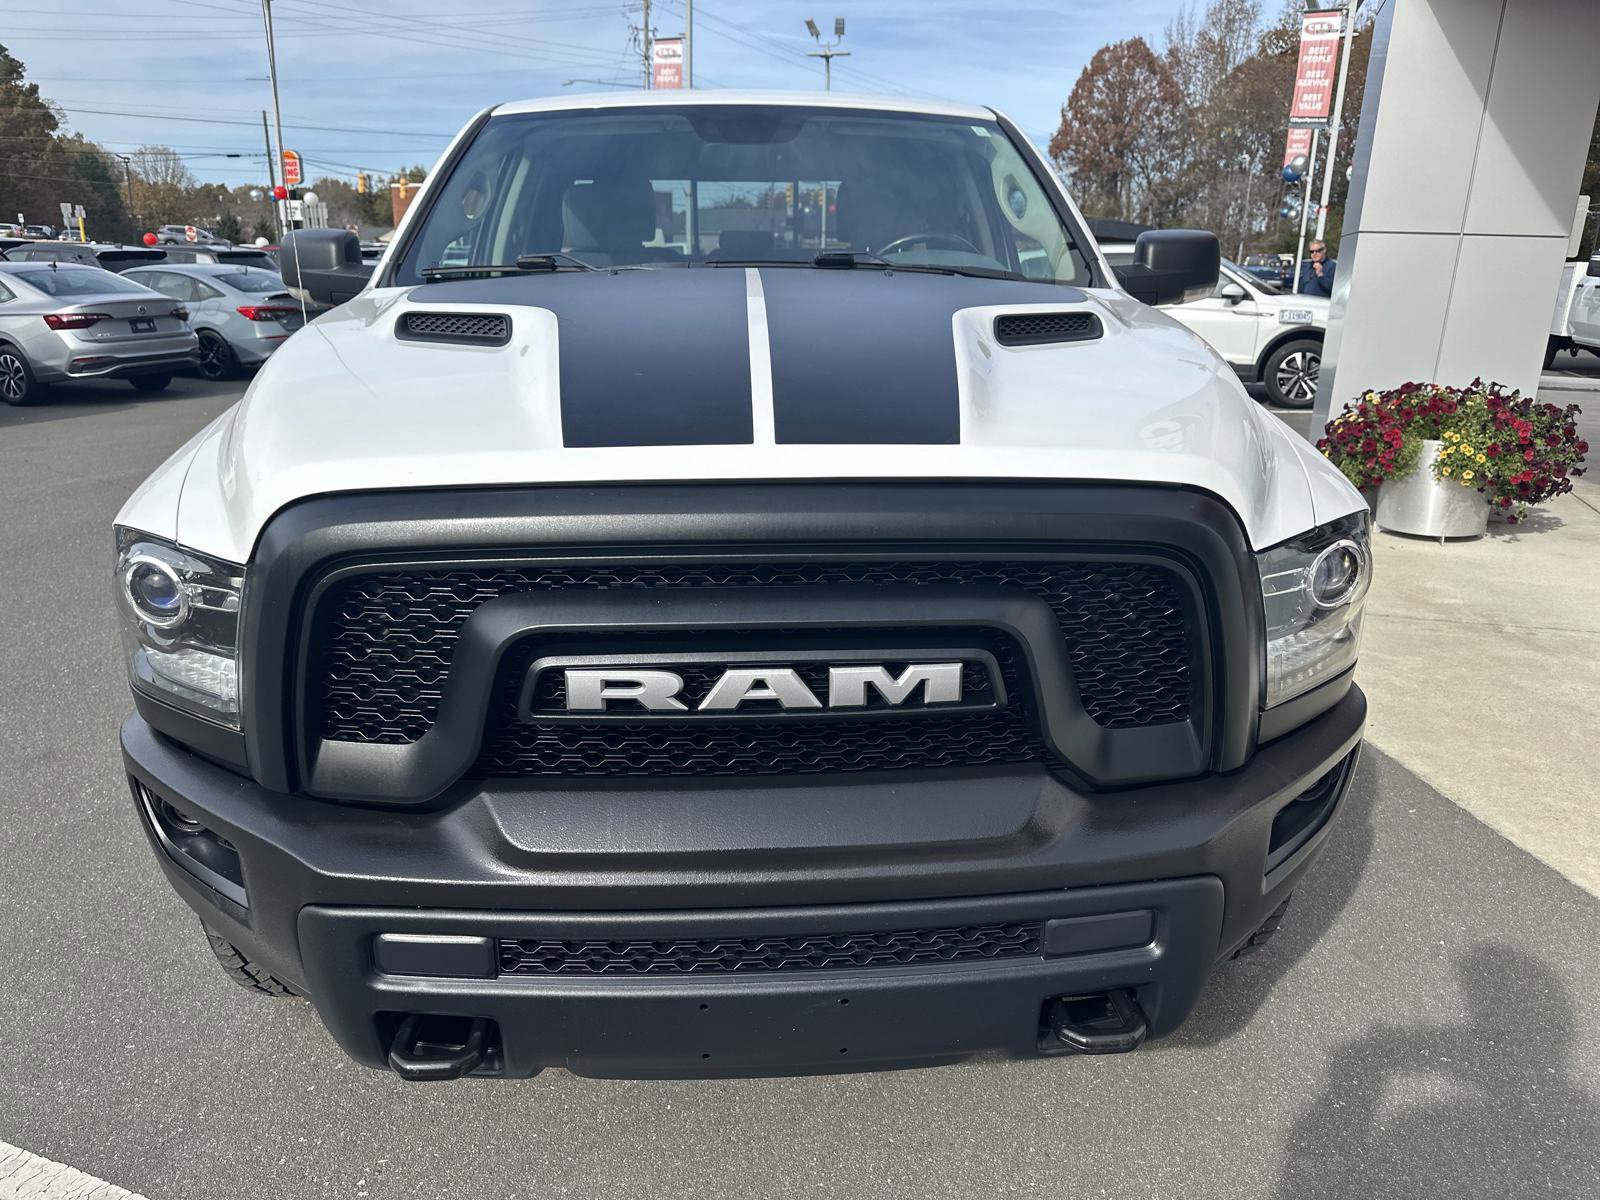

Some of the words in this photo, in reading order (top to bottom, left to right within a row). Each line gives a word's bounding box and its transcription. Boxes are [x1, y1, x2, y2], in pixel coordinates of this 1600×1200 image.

[1308, 46, 1329, 54] BEST
[1302, 55, 1333, 63] PEOPLE
[1305, 70, 1326, 78] BEST
[1297, 79, 1330, 87] SERVICE
[1302, 93, 1323, 101] BEST
[1299, 102, 1323, 110] VALUE
[564, 662, 963, 711] RAM
